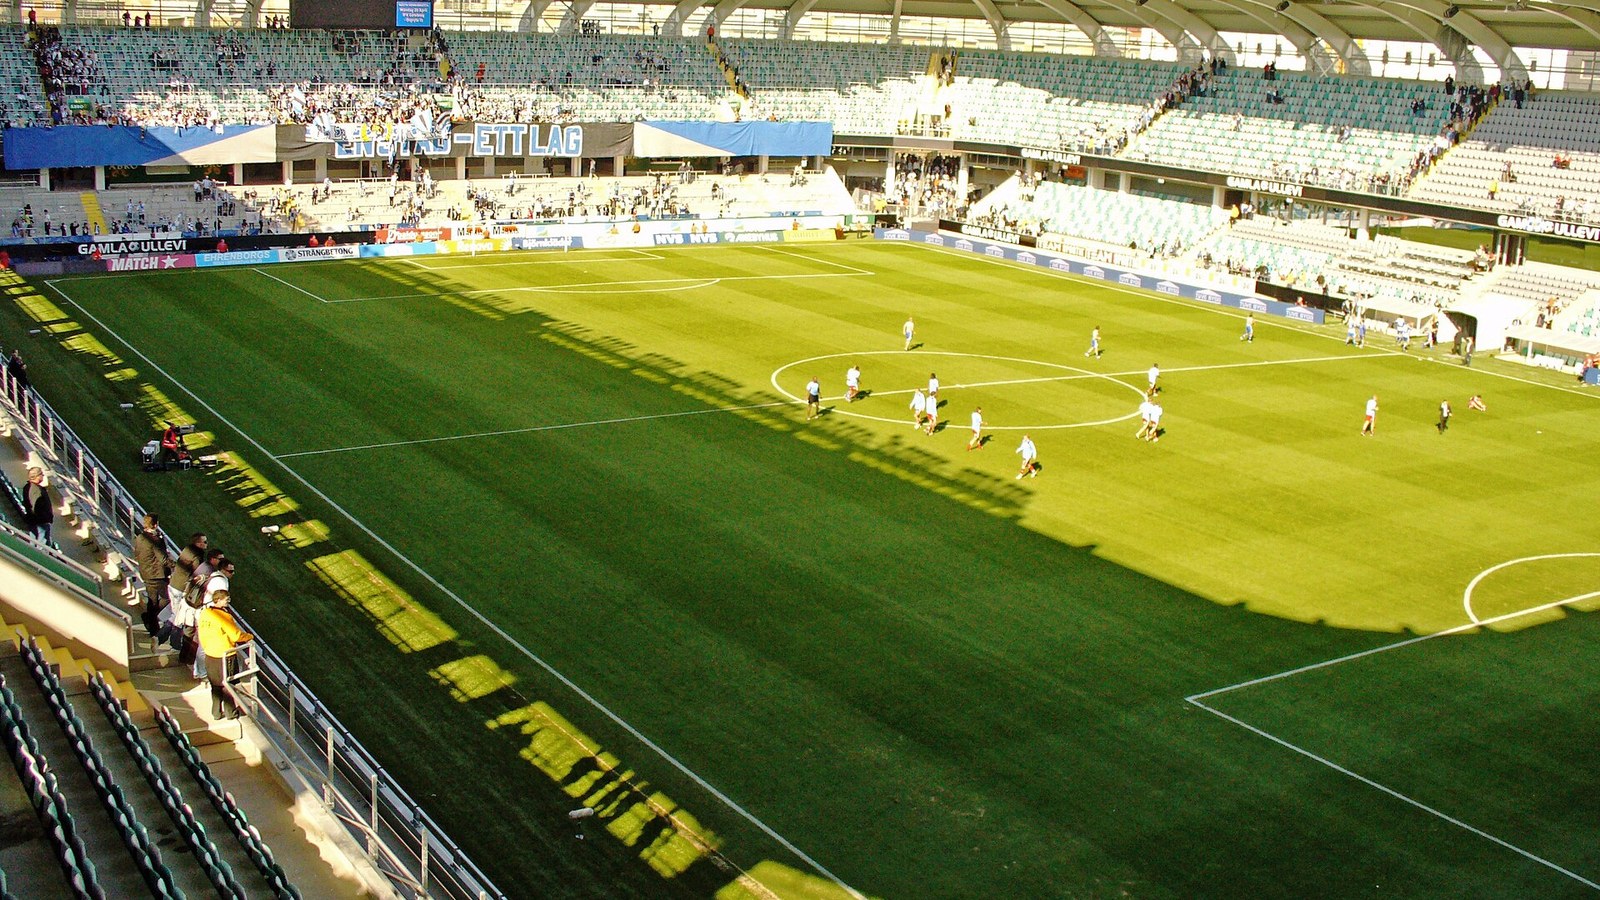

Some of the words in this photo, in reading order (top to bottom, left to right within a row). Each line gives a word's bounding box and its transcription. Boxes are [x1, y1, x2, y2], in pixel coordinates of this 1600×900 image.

[529, 124, 582, 157] LAG
[1227, 176, 1260, 191] GAMLA
[1269, 182, 1303, 197] ULLEVI
[1554, 222, 1600, 241] ULLEVI
[78, 242, 129, 255] GAMLA
[140, 239, 187, 252] ULLEVI
[111, 256, 159, 272] MATCH
[203, 251, 271, 262] EHRENBORGS
